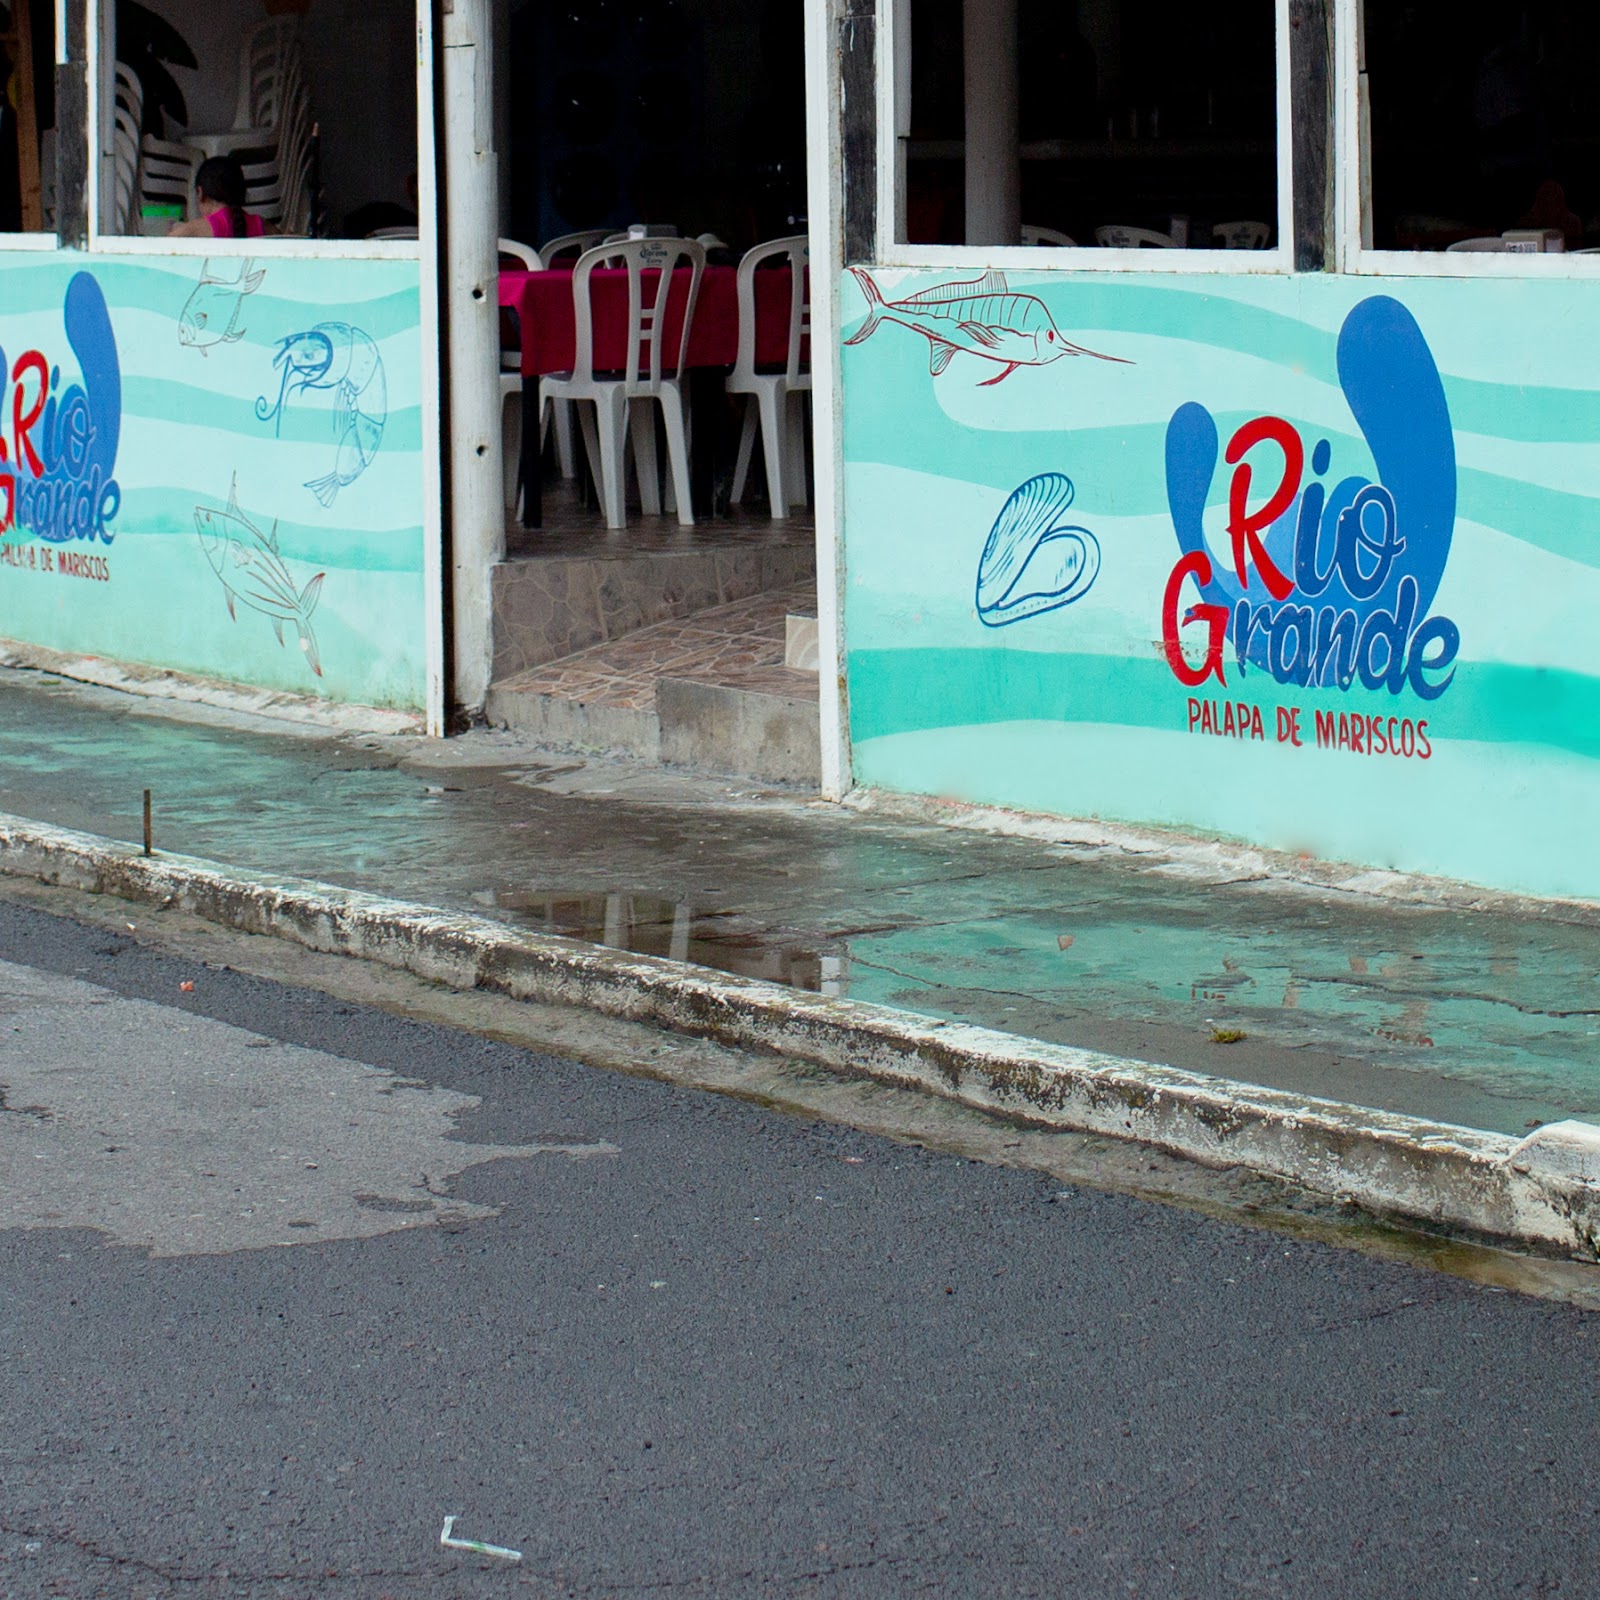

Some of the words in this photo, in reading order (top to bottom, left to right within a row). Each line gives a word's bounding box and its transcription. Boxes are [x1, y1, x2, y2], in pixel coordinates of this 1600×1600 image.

[12, 349, 97, 481] Rio
[41, 547, 54, 571] DE
[57, 551, 110, 582] MARISCOS
[1225, 416, 1407, 602] Rio
[1162, 549, 1460, 701] Grande
[1188, 698, 1265, 741] PALAPA
[1276, 706, 1303, 747] DE
[1315, 710, 1432, 759] MARISCOS
